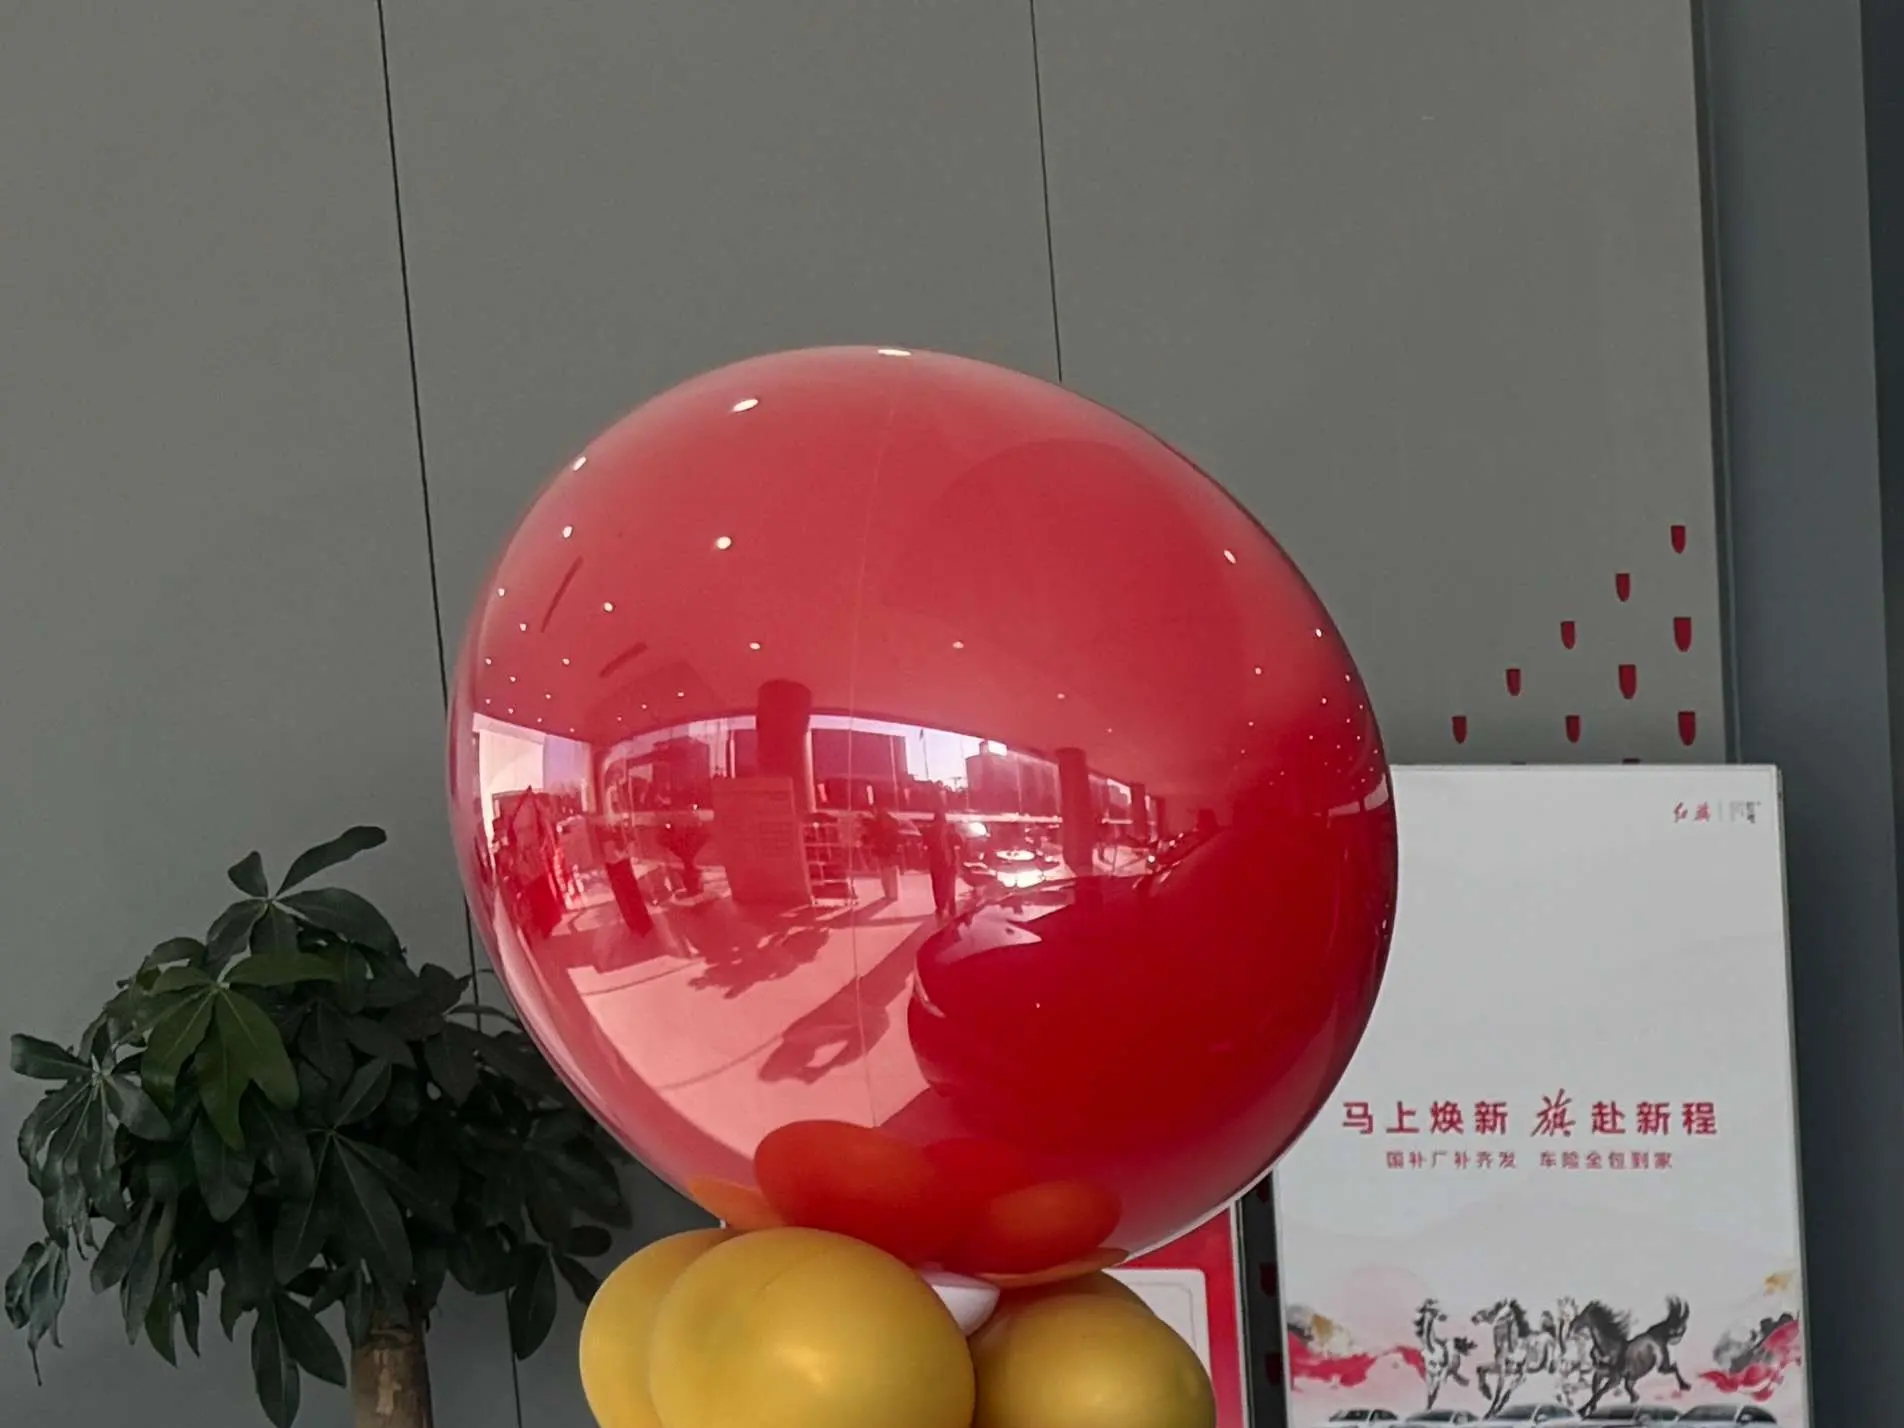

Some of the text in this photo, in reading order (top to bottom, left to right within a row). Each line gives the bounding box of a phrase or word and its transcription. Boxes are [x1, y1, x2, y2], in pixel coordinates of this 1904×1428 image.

[1342, 1088, 1719, 1138] 马上焕新 旗赴新程
